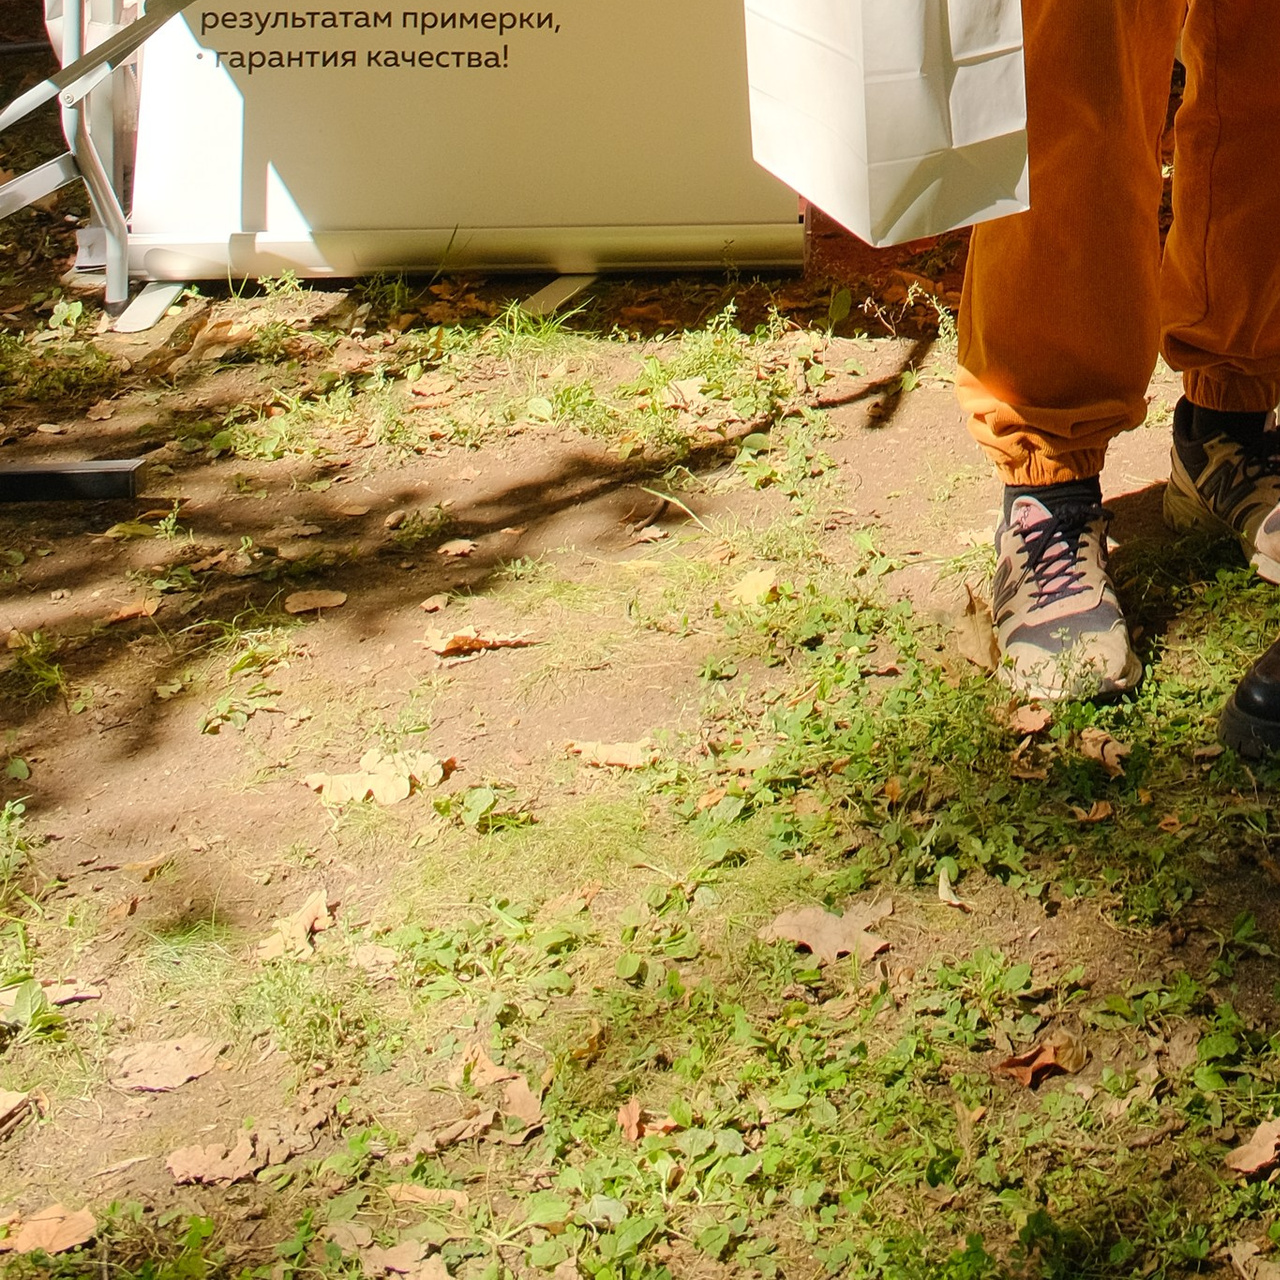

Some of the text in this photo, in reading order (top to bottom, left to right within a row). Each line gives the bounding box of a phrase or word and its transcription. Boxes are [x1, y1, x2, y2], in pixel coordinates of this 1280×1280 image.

[200, 10, 562, 37] результатам примерки,
[216, 43, 509, 76] гарантия качества!
